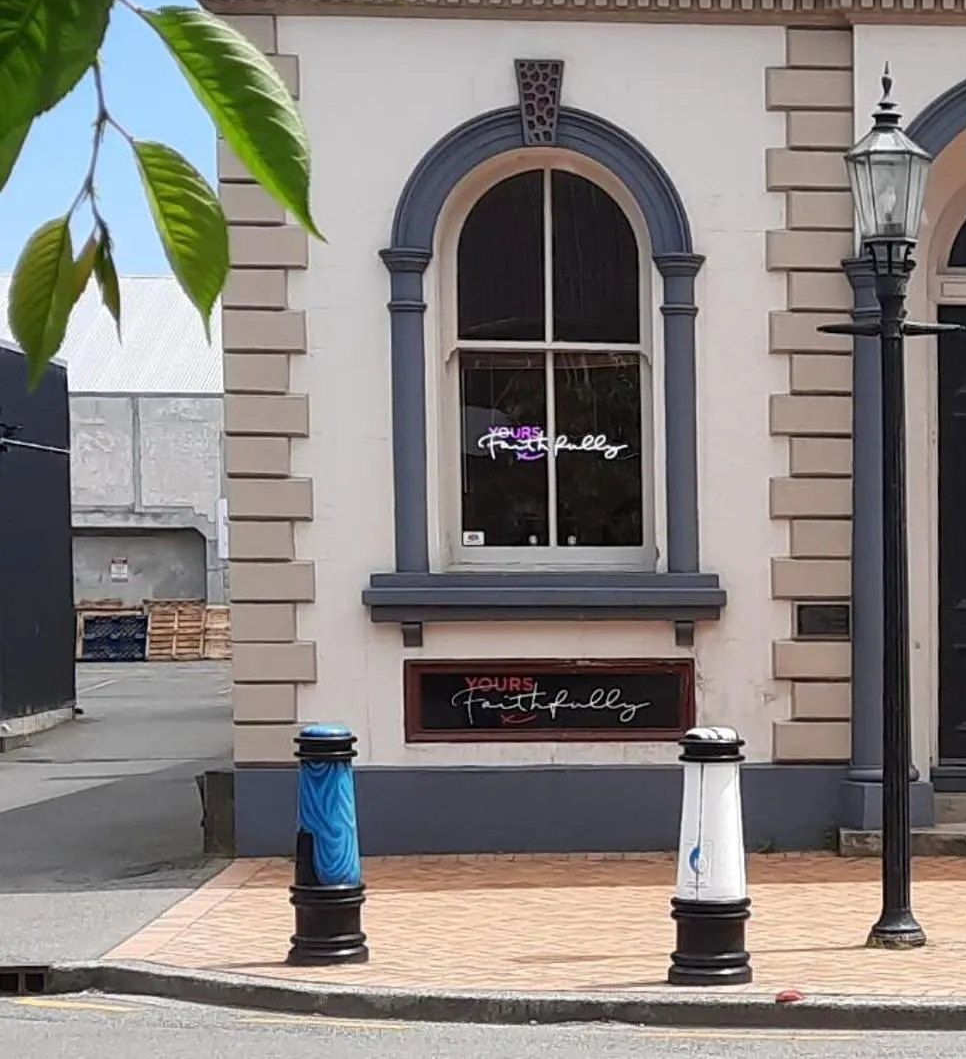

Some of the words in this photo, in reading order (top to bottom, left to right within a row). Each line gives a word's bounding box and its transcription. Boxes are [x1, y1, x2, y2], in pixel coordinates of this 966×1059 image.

[488, 426, 542, 439] YOURS
[478, 430, 628, 460] Faithfully
[465, 676, 535, 692] YOURS
[451, 681, 650, 725] Faithfully
